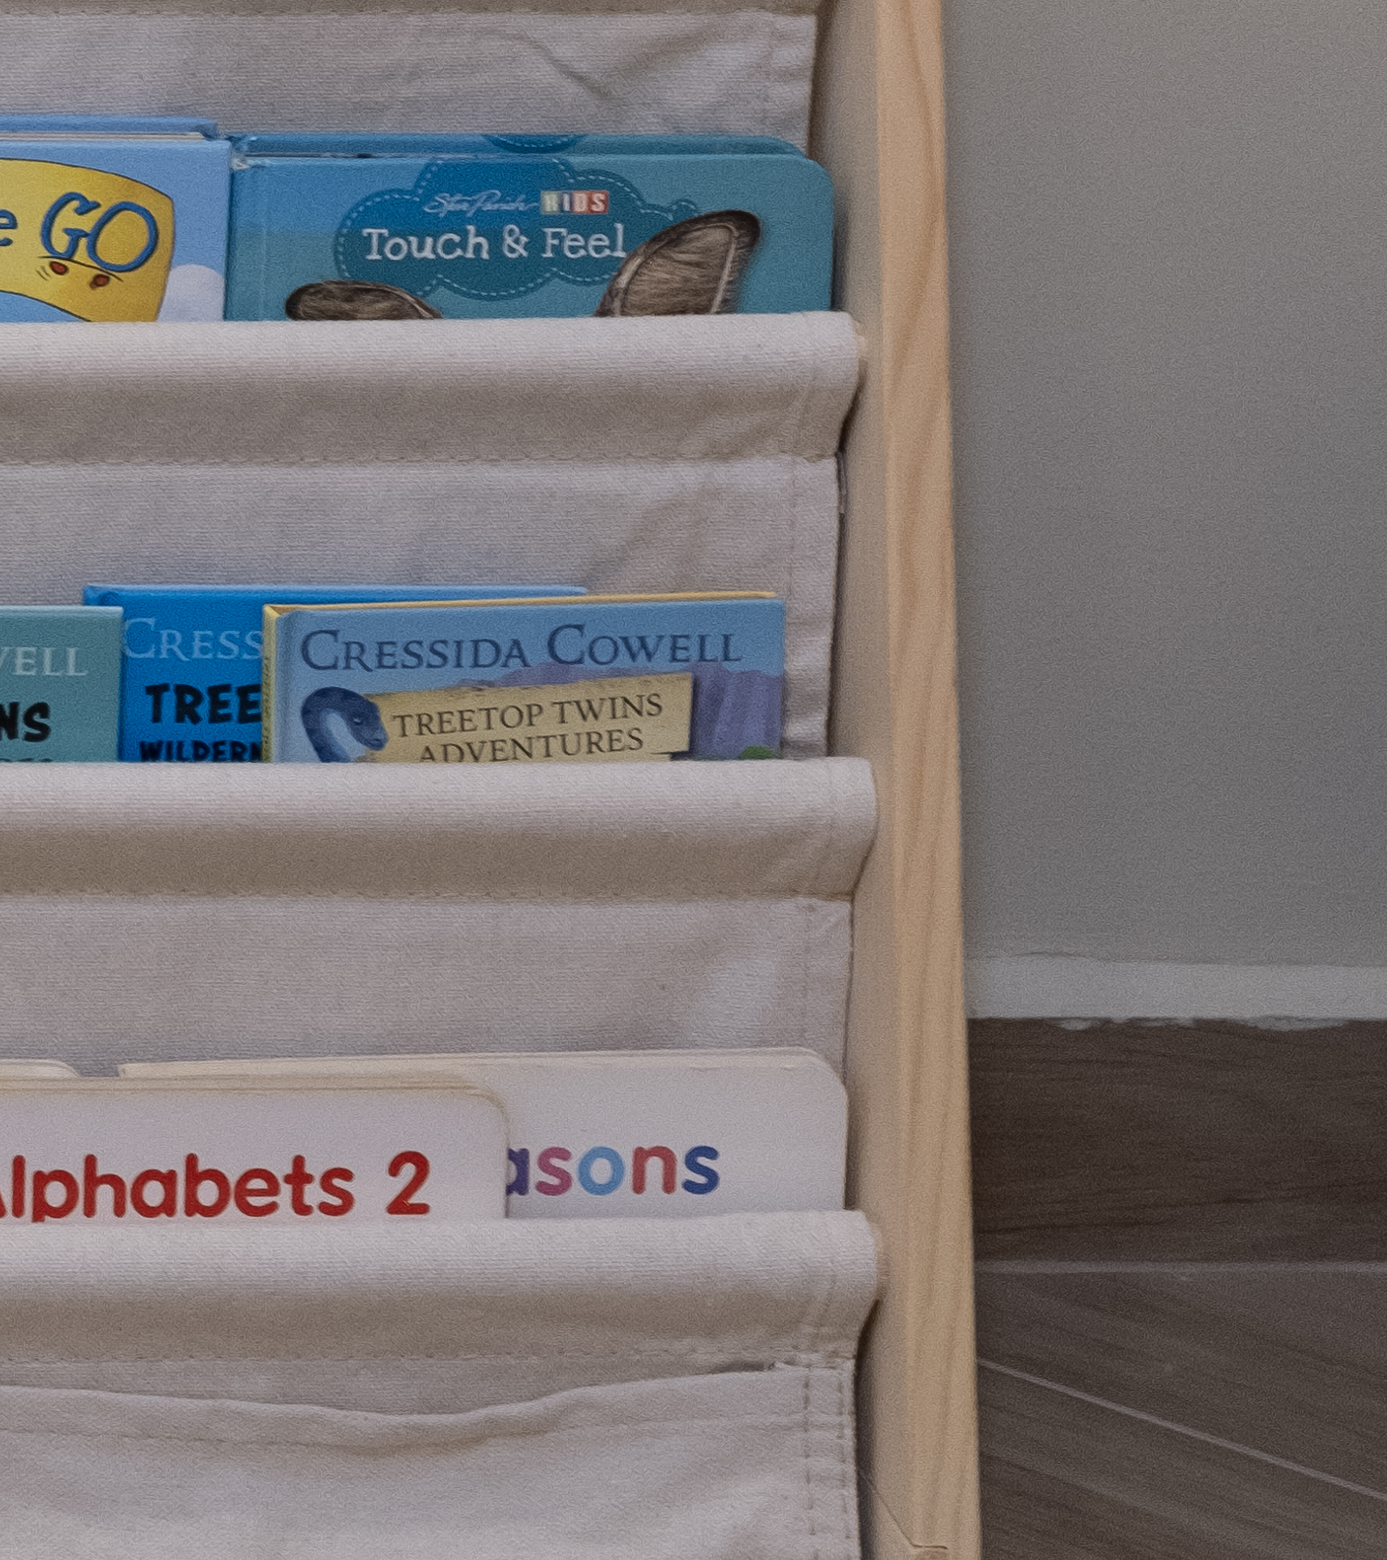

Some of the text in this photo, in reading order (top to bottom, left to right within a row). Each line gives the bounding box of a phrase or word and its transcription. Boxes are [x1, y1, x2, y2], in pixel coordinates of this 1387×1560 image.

[39, 191, 159, 273] GO
[363, 223, 628, 261] Touch & Feel
[301, 622, 742, 674] CRESSIDA COWELL
[391, 692, 663, 739] TREETOP TWINS
[388, 1150, 431, 1215] 2
